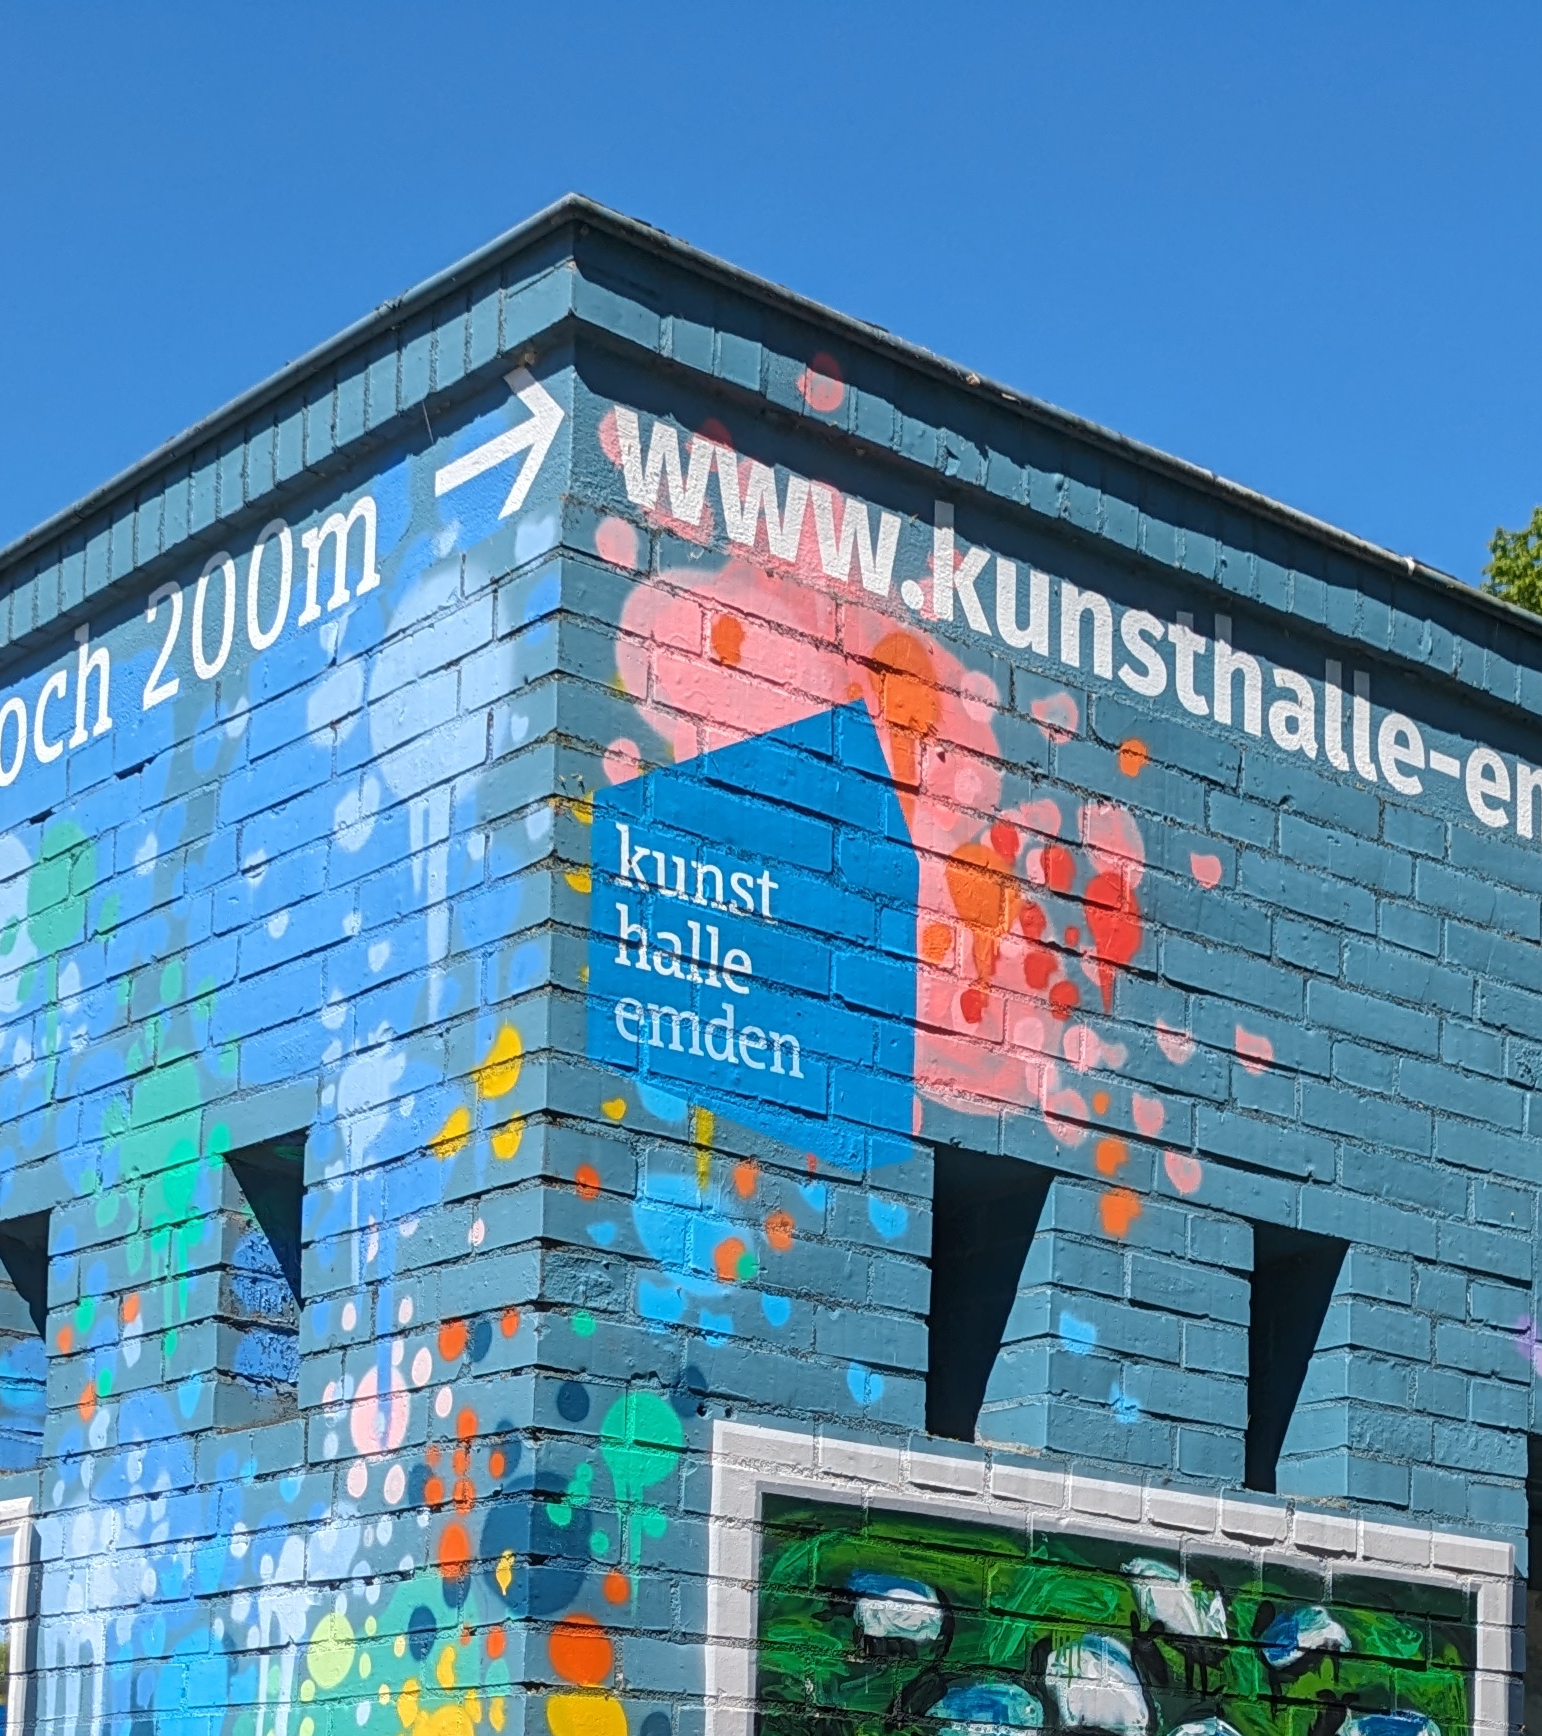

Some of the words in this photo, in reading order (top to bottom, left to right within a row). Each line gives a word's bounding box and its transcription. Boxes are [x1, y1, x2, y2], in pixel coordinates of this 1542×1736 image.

[141, 494, 382, 711] 200m
[613, 822, 779, 924] kunst
[613, 903, 753, 997] halle
[613, 996, 804, 1080] emden
